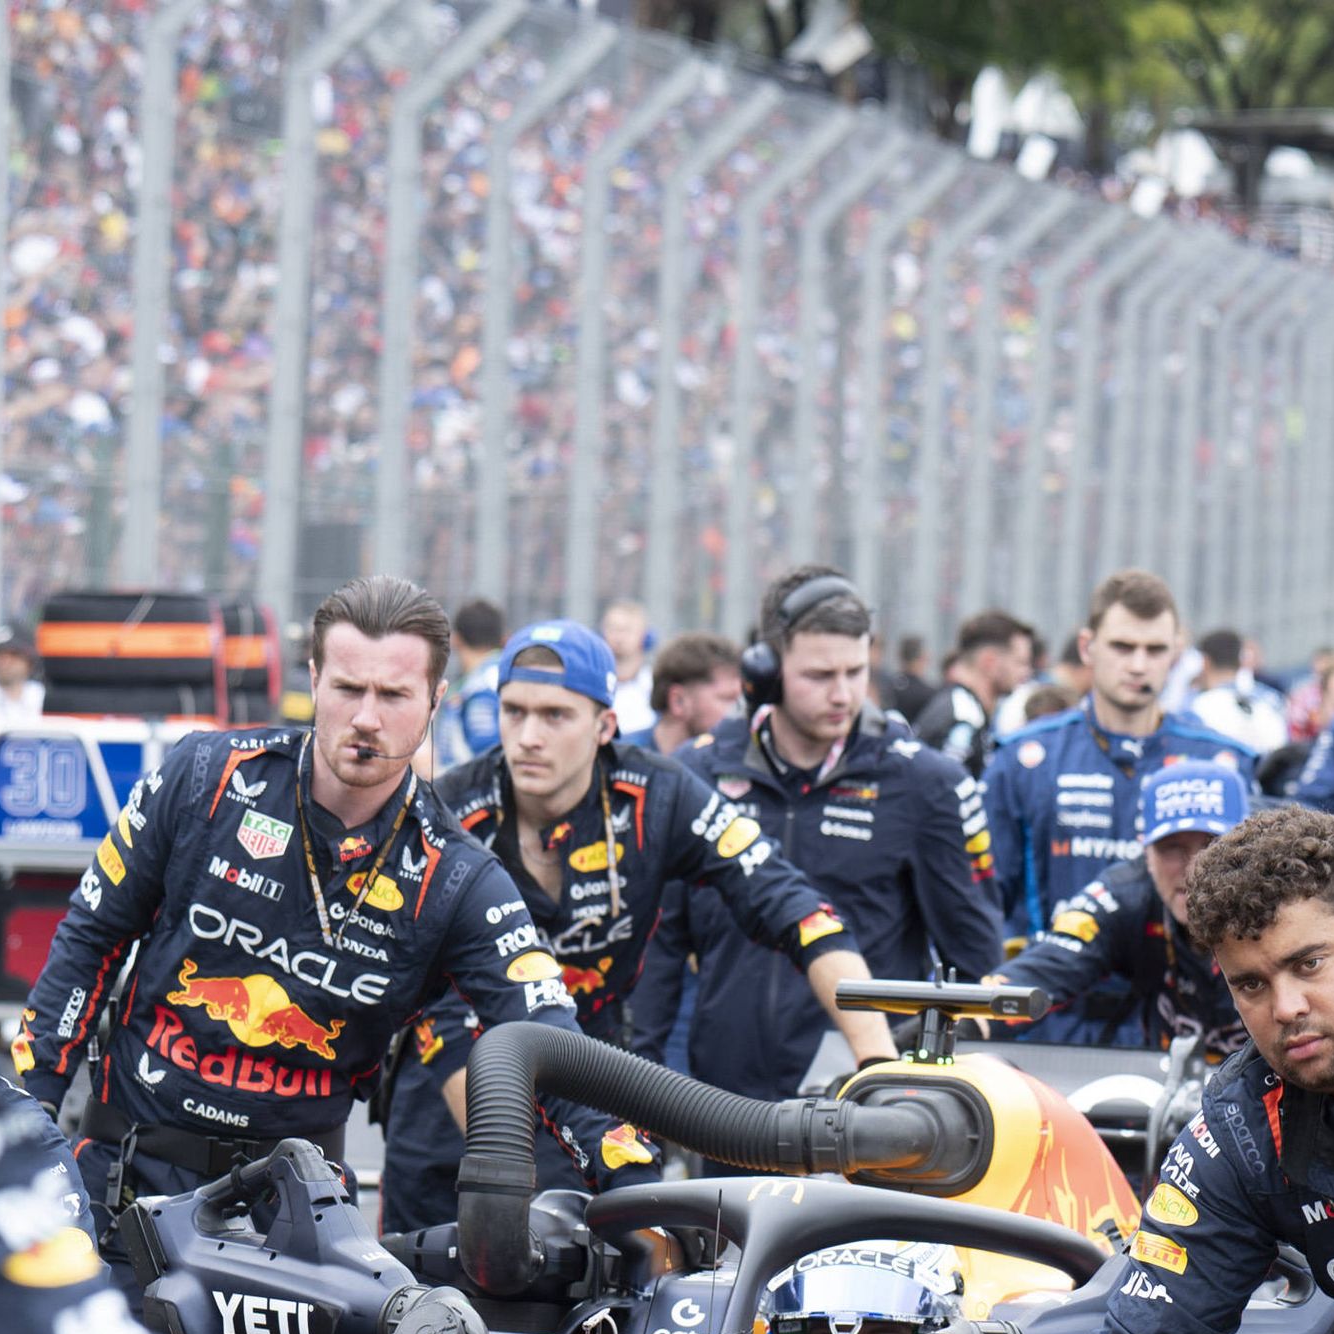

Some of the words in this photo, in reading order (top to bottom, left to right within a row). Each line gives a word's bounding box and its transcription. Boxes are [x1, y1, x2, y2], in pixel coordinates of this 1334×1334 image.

[238, 828, 286, 857] HEUER
[246, 815, 289, 841] TAG
[208, 856, 264, 895] Mobil
[188, 903, 391, 1005] ORACLE
[331, 932, 390, 963] ONDA
[56, 987, 86, 1038] sparco
[183, 1098, 250, 1128] C.ADAMS
[1221, 1102, 1267, 1178] sparco
[795, 1248, 911, 1277] ORACLE
